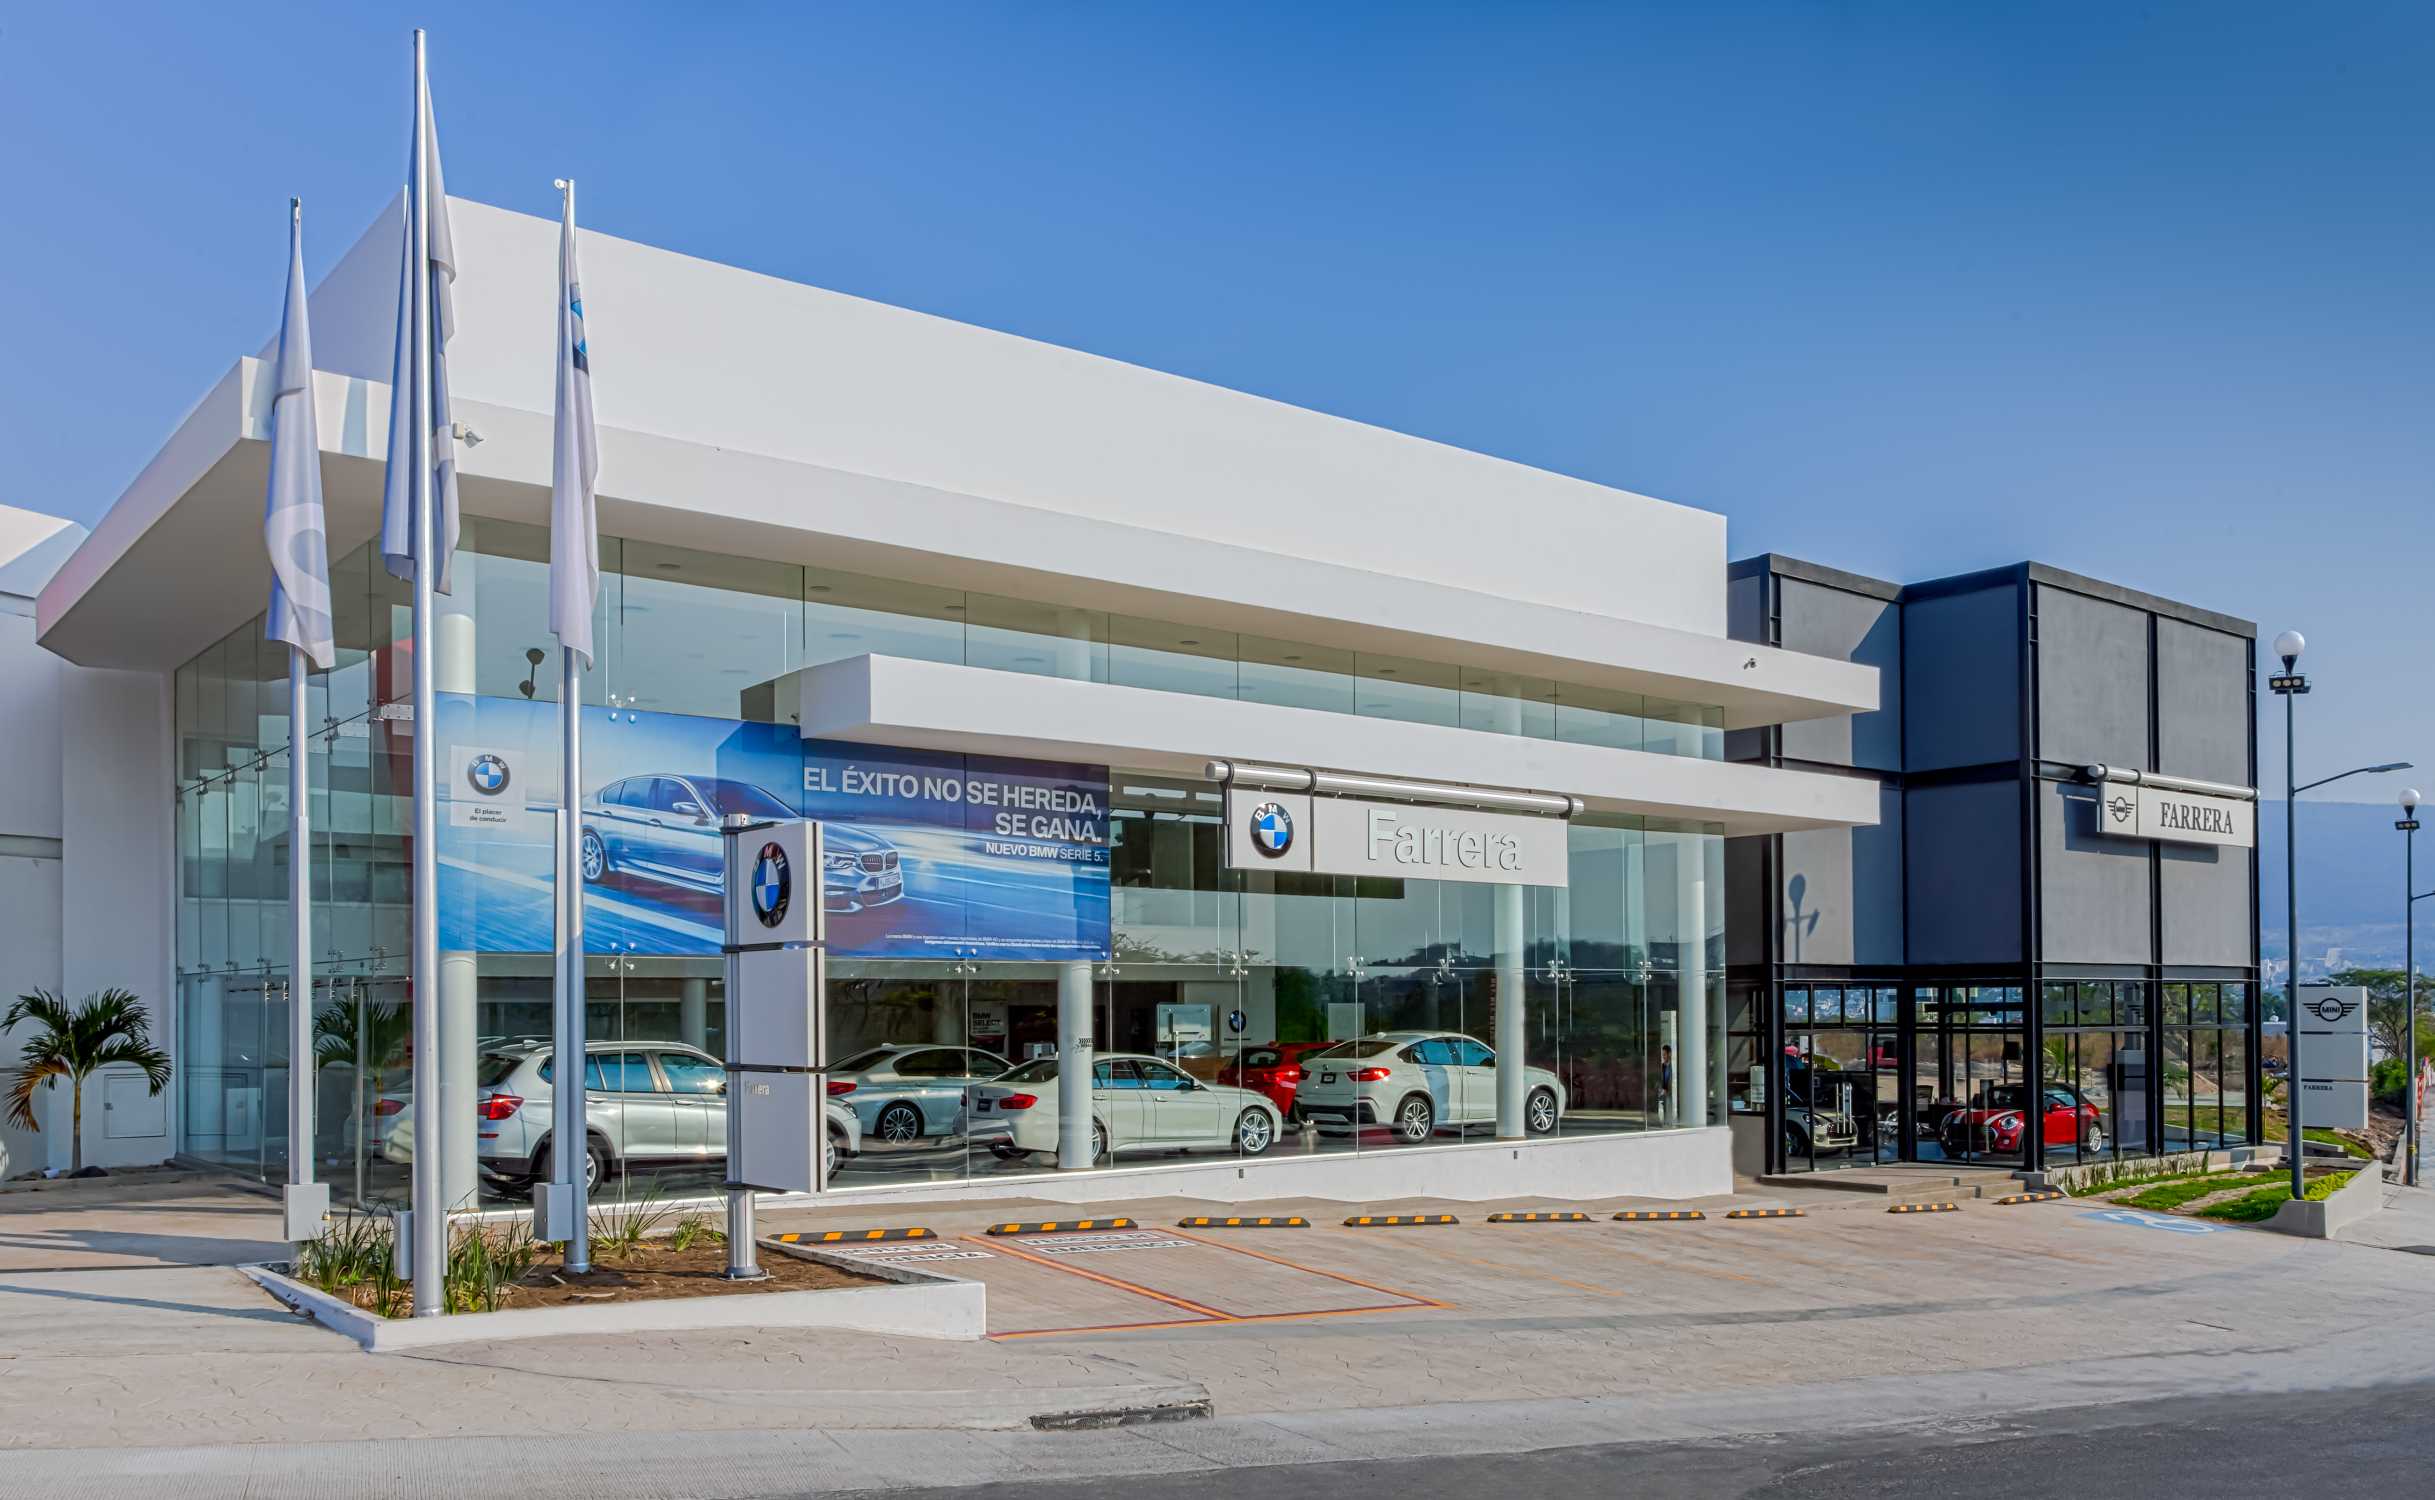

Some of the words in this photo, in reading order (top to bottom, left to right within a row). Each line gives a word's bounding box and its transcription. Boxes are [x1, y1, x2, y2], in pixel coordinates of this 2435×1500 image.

[804, 767, 837, 792] EL
[842, 766, 918, 798] ÉXITO
[924, 776, 961, 802] NO
[966, 781, 998, 806] SE
[1003, 785, 1102, 820] HEREDA,
[995, 812, 1027, 837] SE
[1031, 815, 1102, 843] GANA.
[2160, 802, 2234, 834] FARRERA
[986, 842, 1027, 857] NUEVO
[1029, 845, 1059, 859] BMW
[1059, 848, 1092, 861] SERIE
[1368, 808, 1522, 871] Farrera
